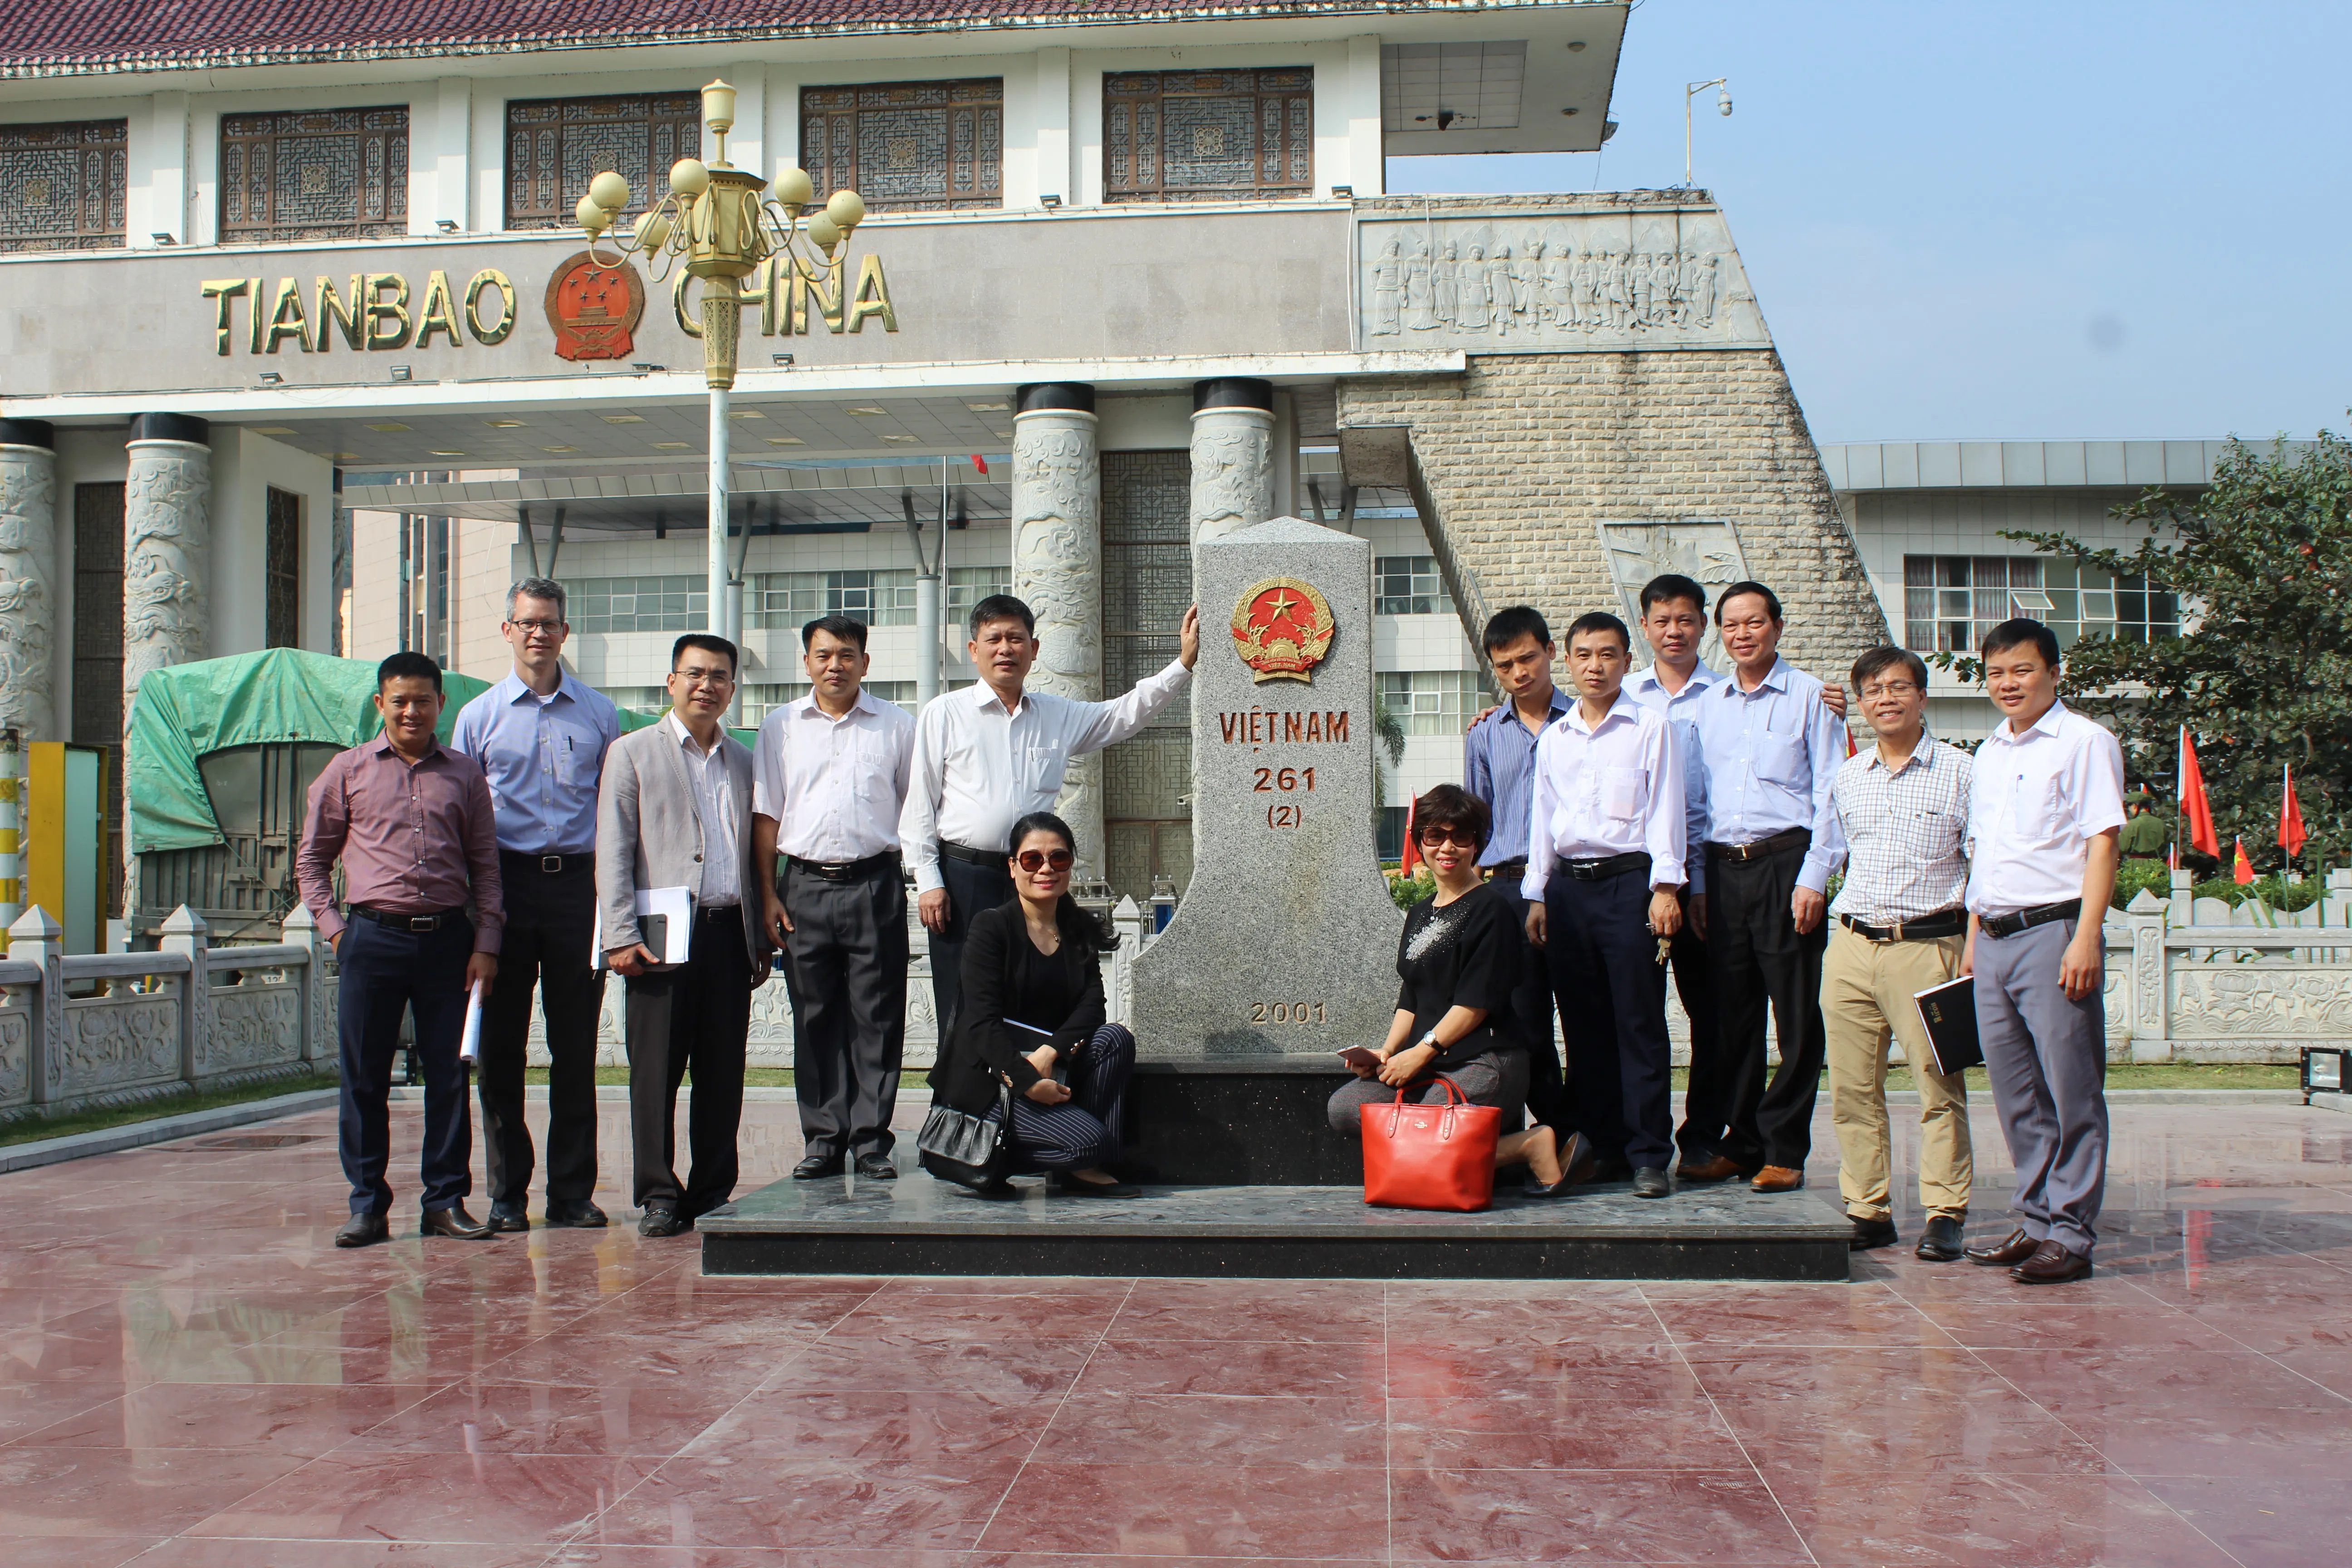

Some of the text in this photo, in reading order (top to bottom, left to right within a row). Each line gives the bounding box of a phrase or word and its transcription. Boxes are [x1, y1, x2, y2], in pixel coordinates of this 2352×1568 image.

[201, 269, 516, 356] TIANBAO
[1219, 706, 1349, 754] VIỆT NAM
[1254, 767, 1316, 792] 261
[1268, 805, 1302, 829] (2)
[1250, 1001, 1326, 1024] 2001
